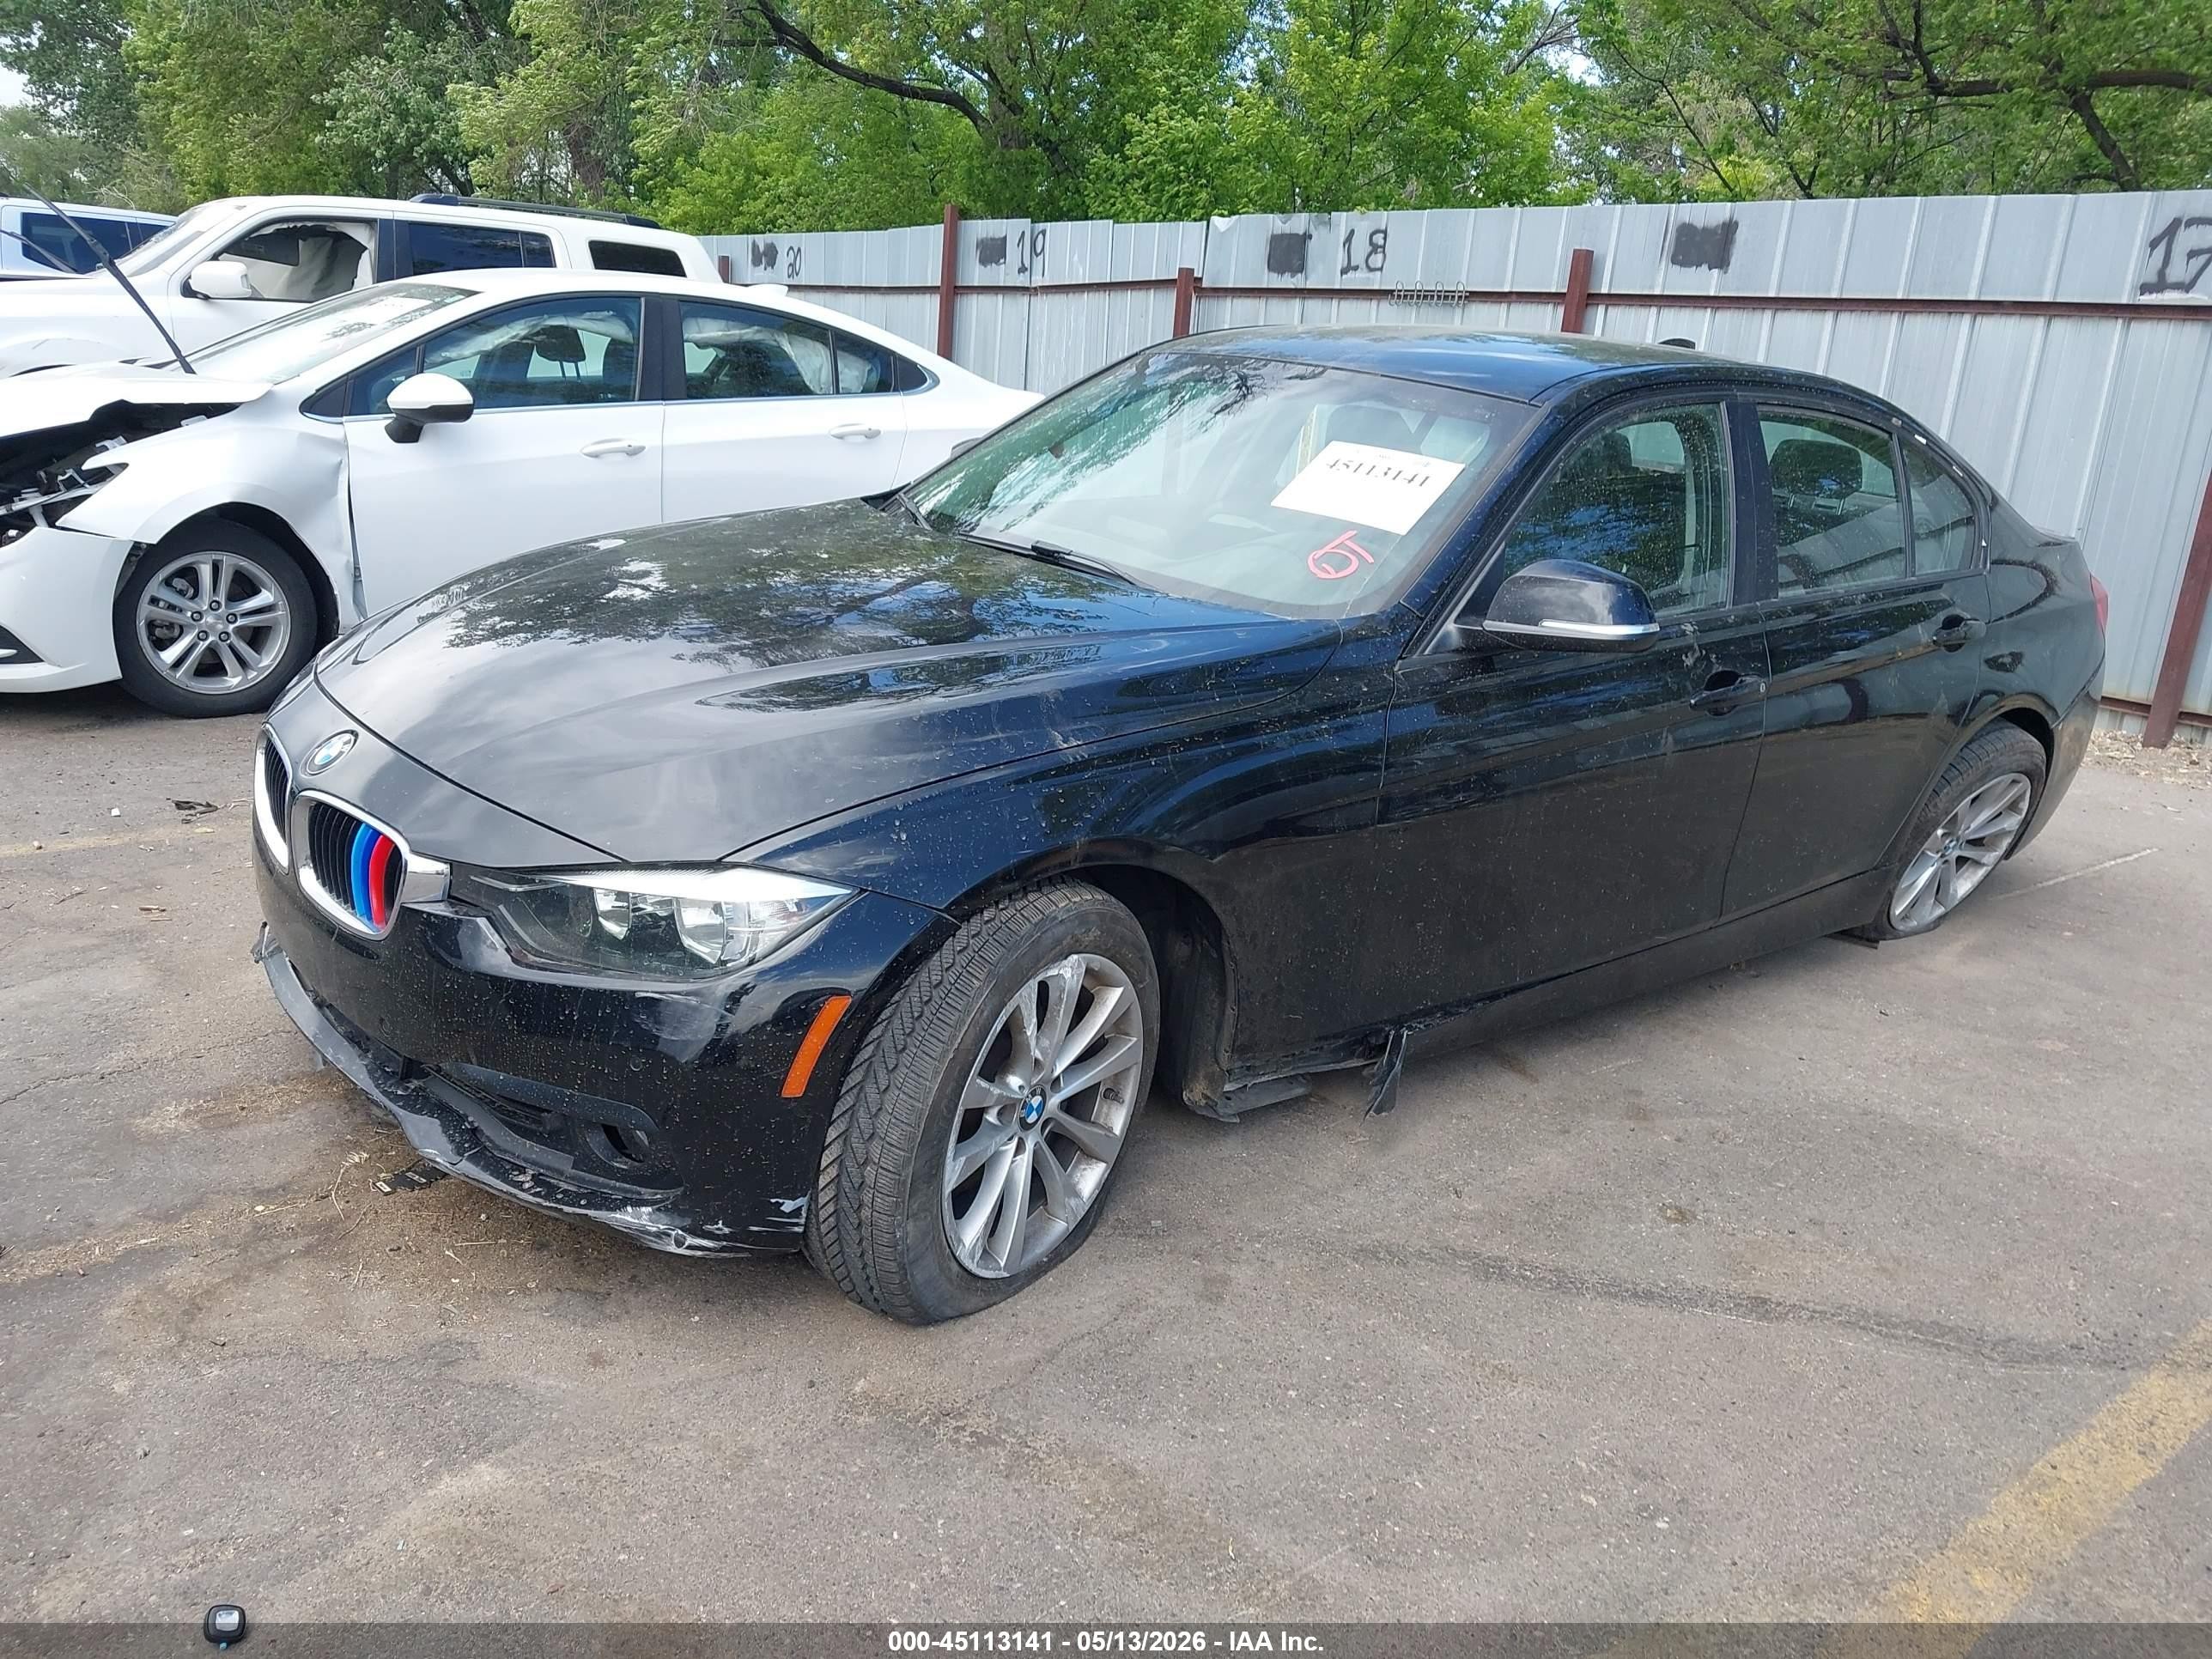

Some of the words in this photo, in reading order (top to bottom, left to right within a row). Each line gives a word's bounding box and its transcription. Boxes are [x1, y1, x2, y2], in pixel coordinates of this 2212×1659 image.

[787, 246, 802, 280] 20
[1017, 228, 1046, 279] 19
[1340, 228, 1388, 276] 18
